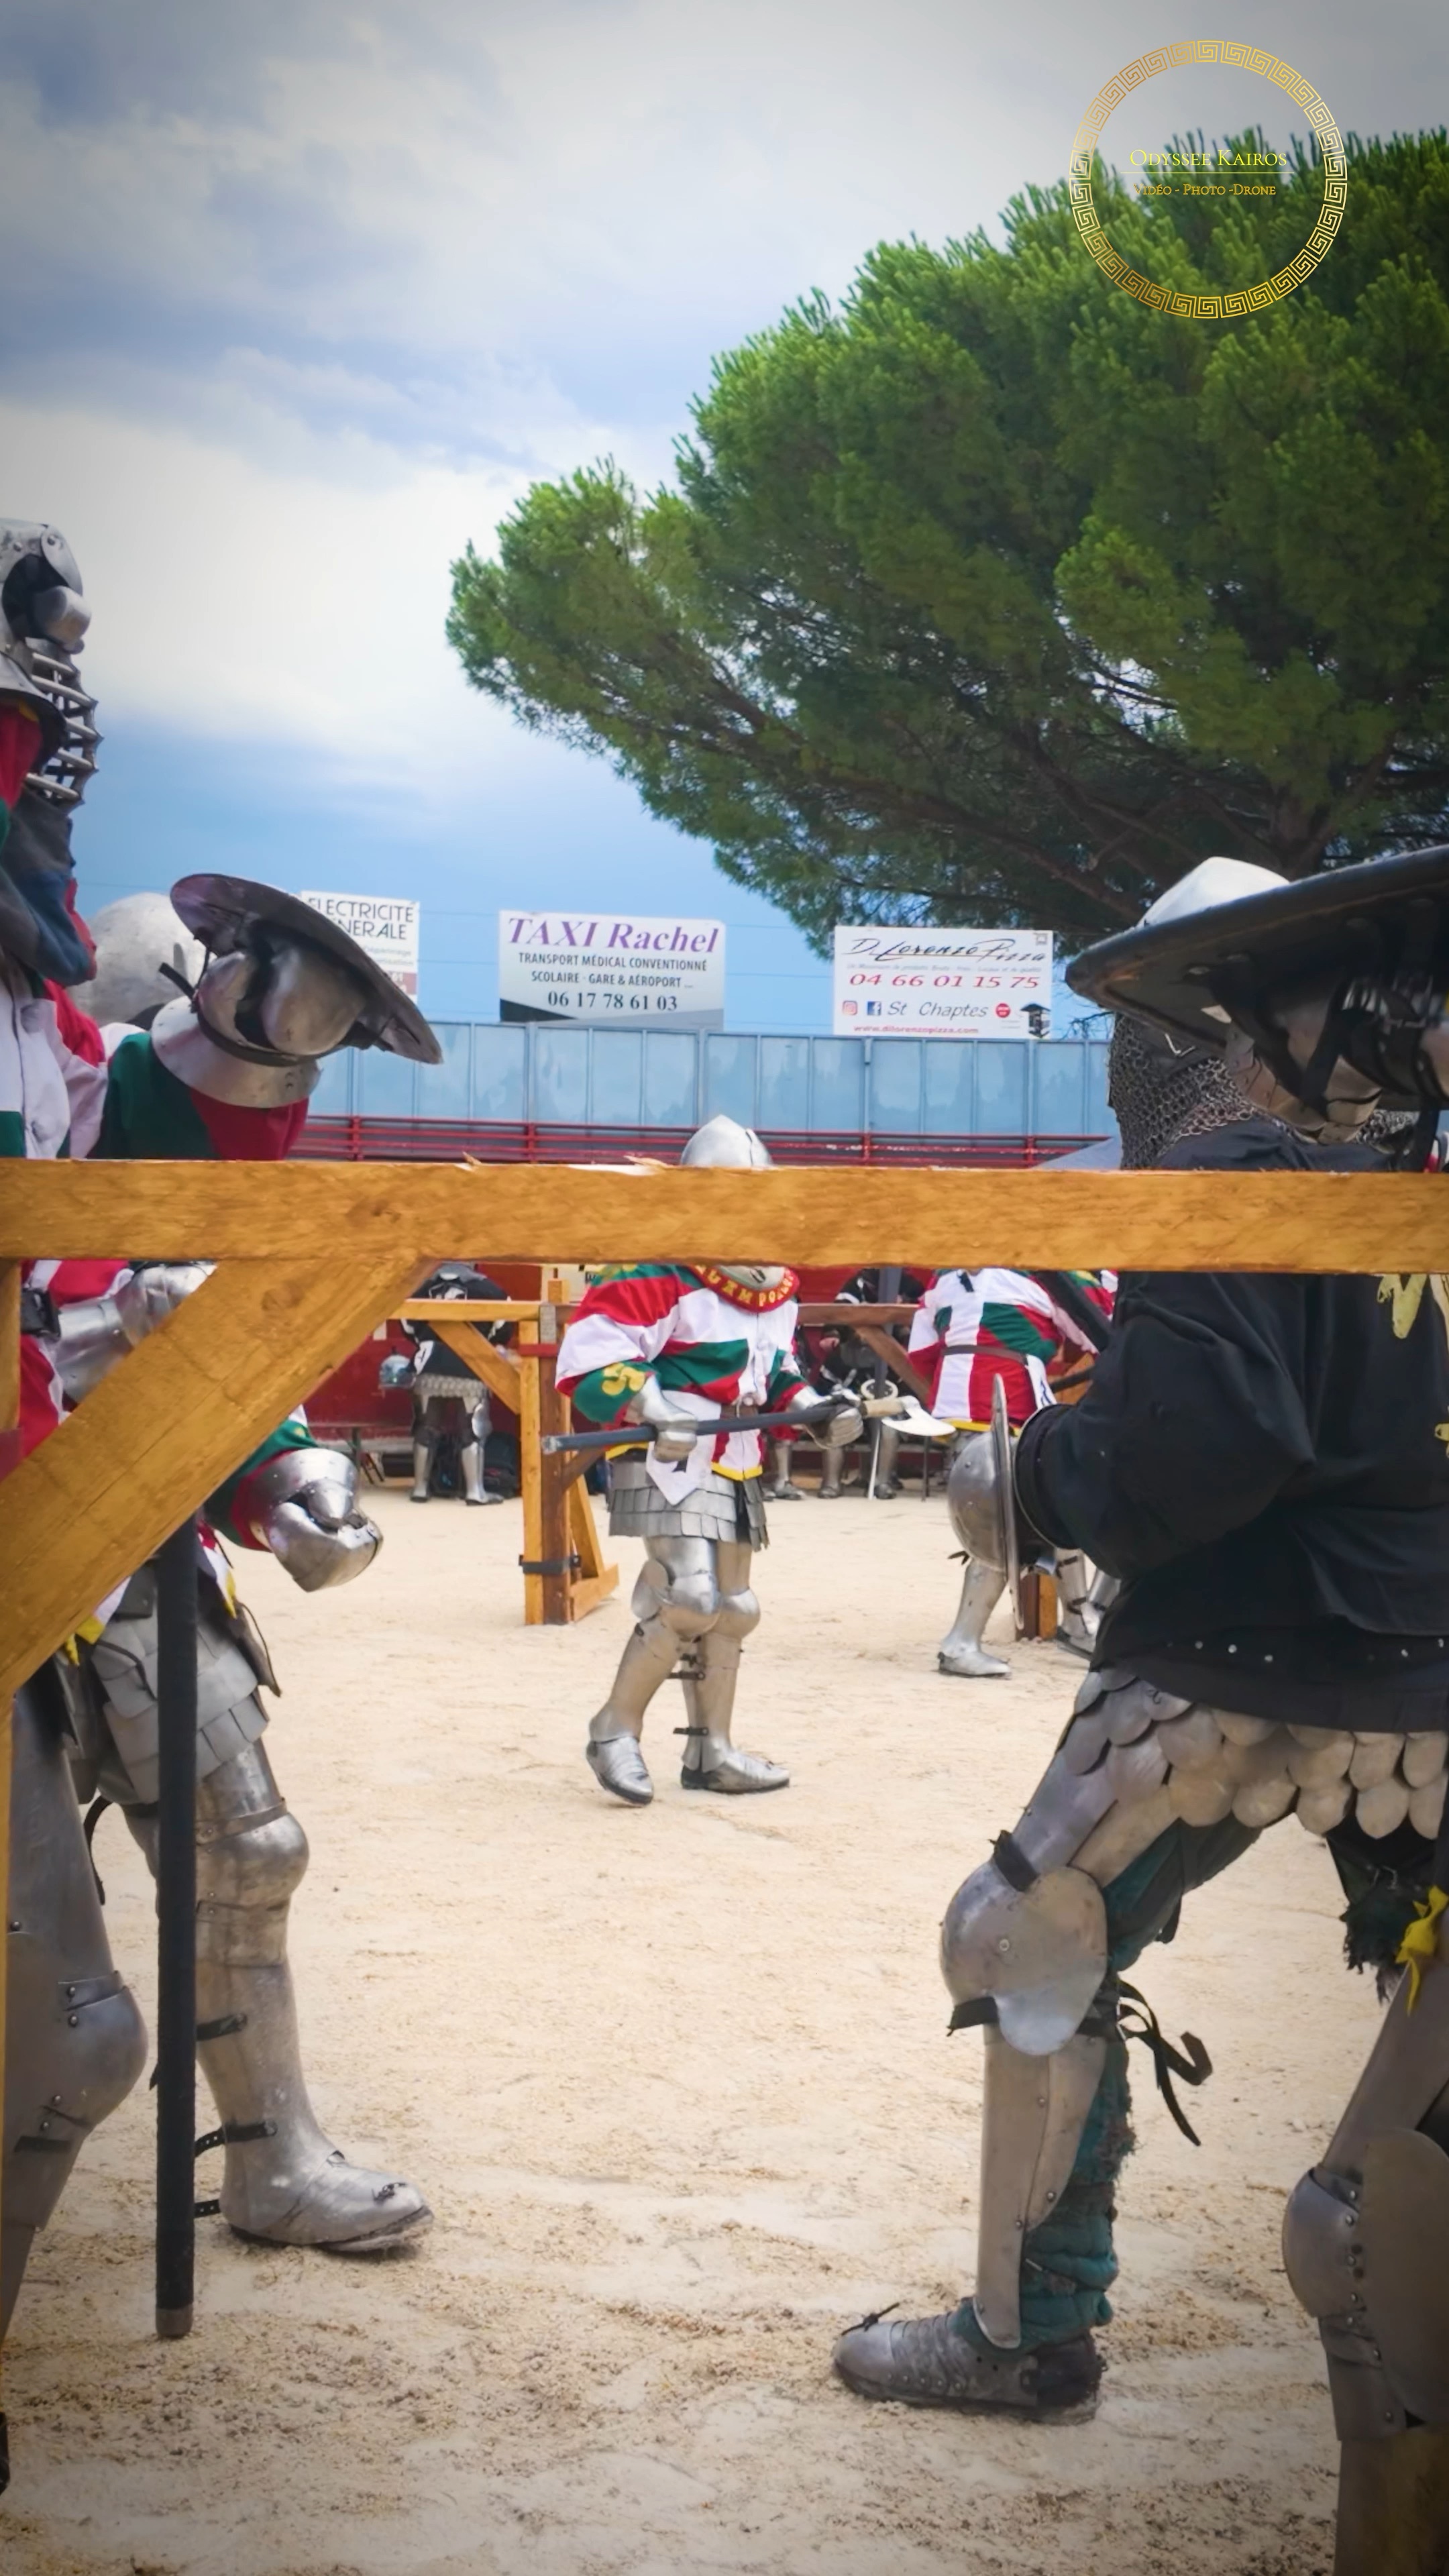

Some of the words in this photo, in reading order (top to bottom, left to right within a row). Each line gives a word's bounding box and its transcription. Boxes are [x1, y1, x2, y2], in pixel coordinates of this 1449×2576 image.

[508, 918, 598, 947] TAXI
[606, 923, 719, 953] Rachel
[519, 953, 579, 966] TRANSPORT
[582, 954, 626, 967] MÉDICAL
[629, 957, 706, 971] CONVENTIONNÉ
[531, 971, 580, 983] SCOLAIRE
[588, 973, 614, 985] GARE
[618, 975, 625, 985] &
[629, 974, 682, 987] AÉROPORT
[850, 973, 882, 985] 04
[892, 975, 924, 986] 66
[934, 975, 963, 987] 01
[973, 976, 1002, 988] 15
[1010, 976, 1040, 988] 75
[548, 991, 569, 1007] 06
[577, 992, 596, 1008] 17
[603, 993, 623, 1009] 78
[630, 994, 648, 1010] 61
[657, 995, 677, 1011] 03
[888, 1002, 908, 1016] St
[919, 1002, 988, 1020] Chaptes
